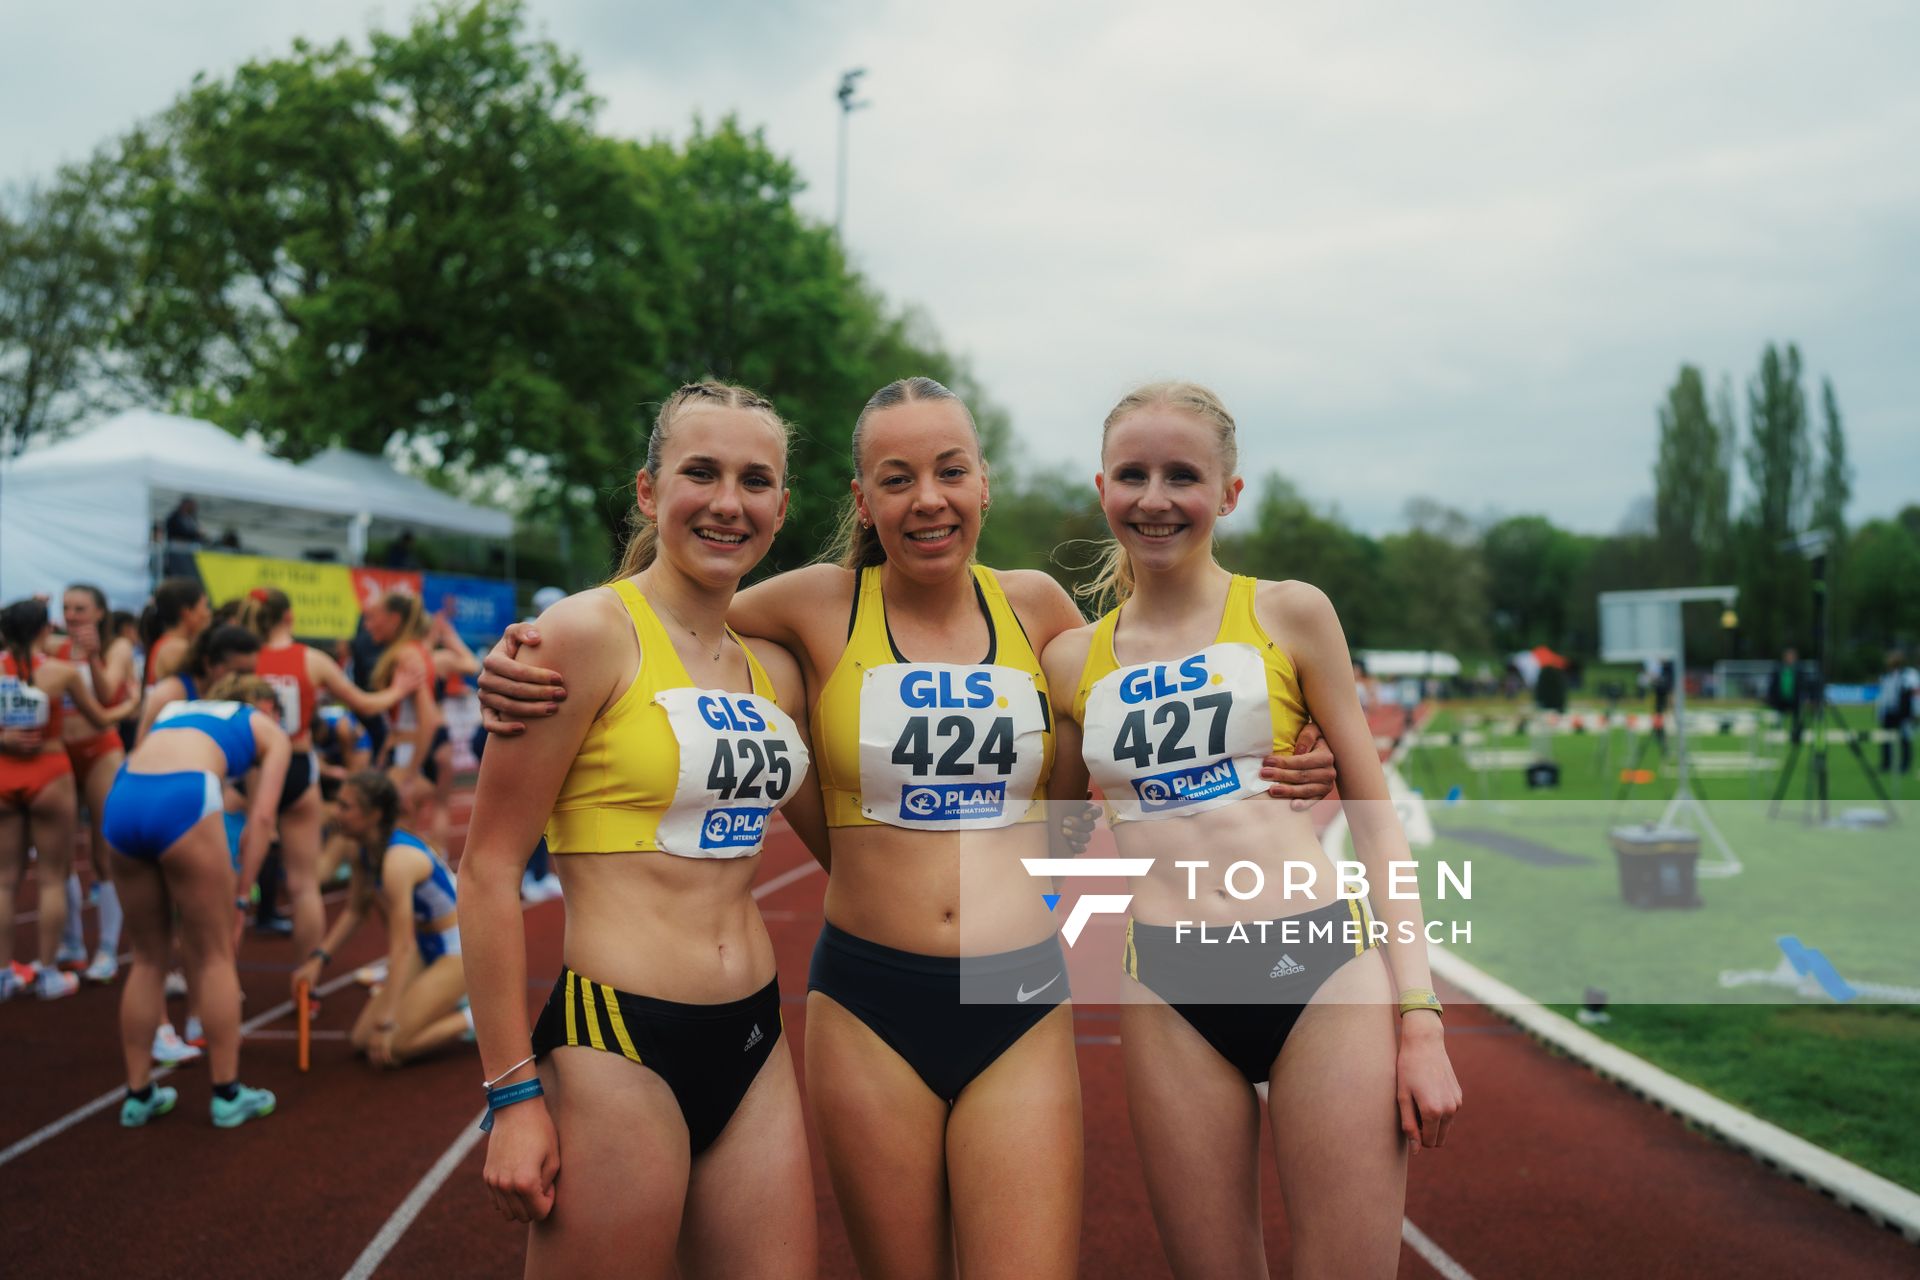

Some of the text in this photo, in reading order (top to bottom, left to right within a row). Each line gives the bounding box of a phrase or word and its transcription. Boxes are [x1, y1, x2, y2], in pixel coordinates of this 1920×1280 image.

[1112, 691, 1234, 770] 427
[890, 715, 1018, 777] 424
[706, 738, 792, 801] 425
[1172, 762, 1233, 794] PLAN
[945, 789, 1001, 807] PLAN
[1177, 780, 1236, 802] INTERNATIONAL
[944, 807, 999, 815] INTERNATIONAL
[733, 813, 768, 832] PLA
[1269, 964, 1305, 979] adidas
